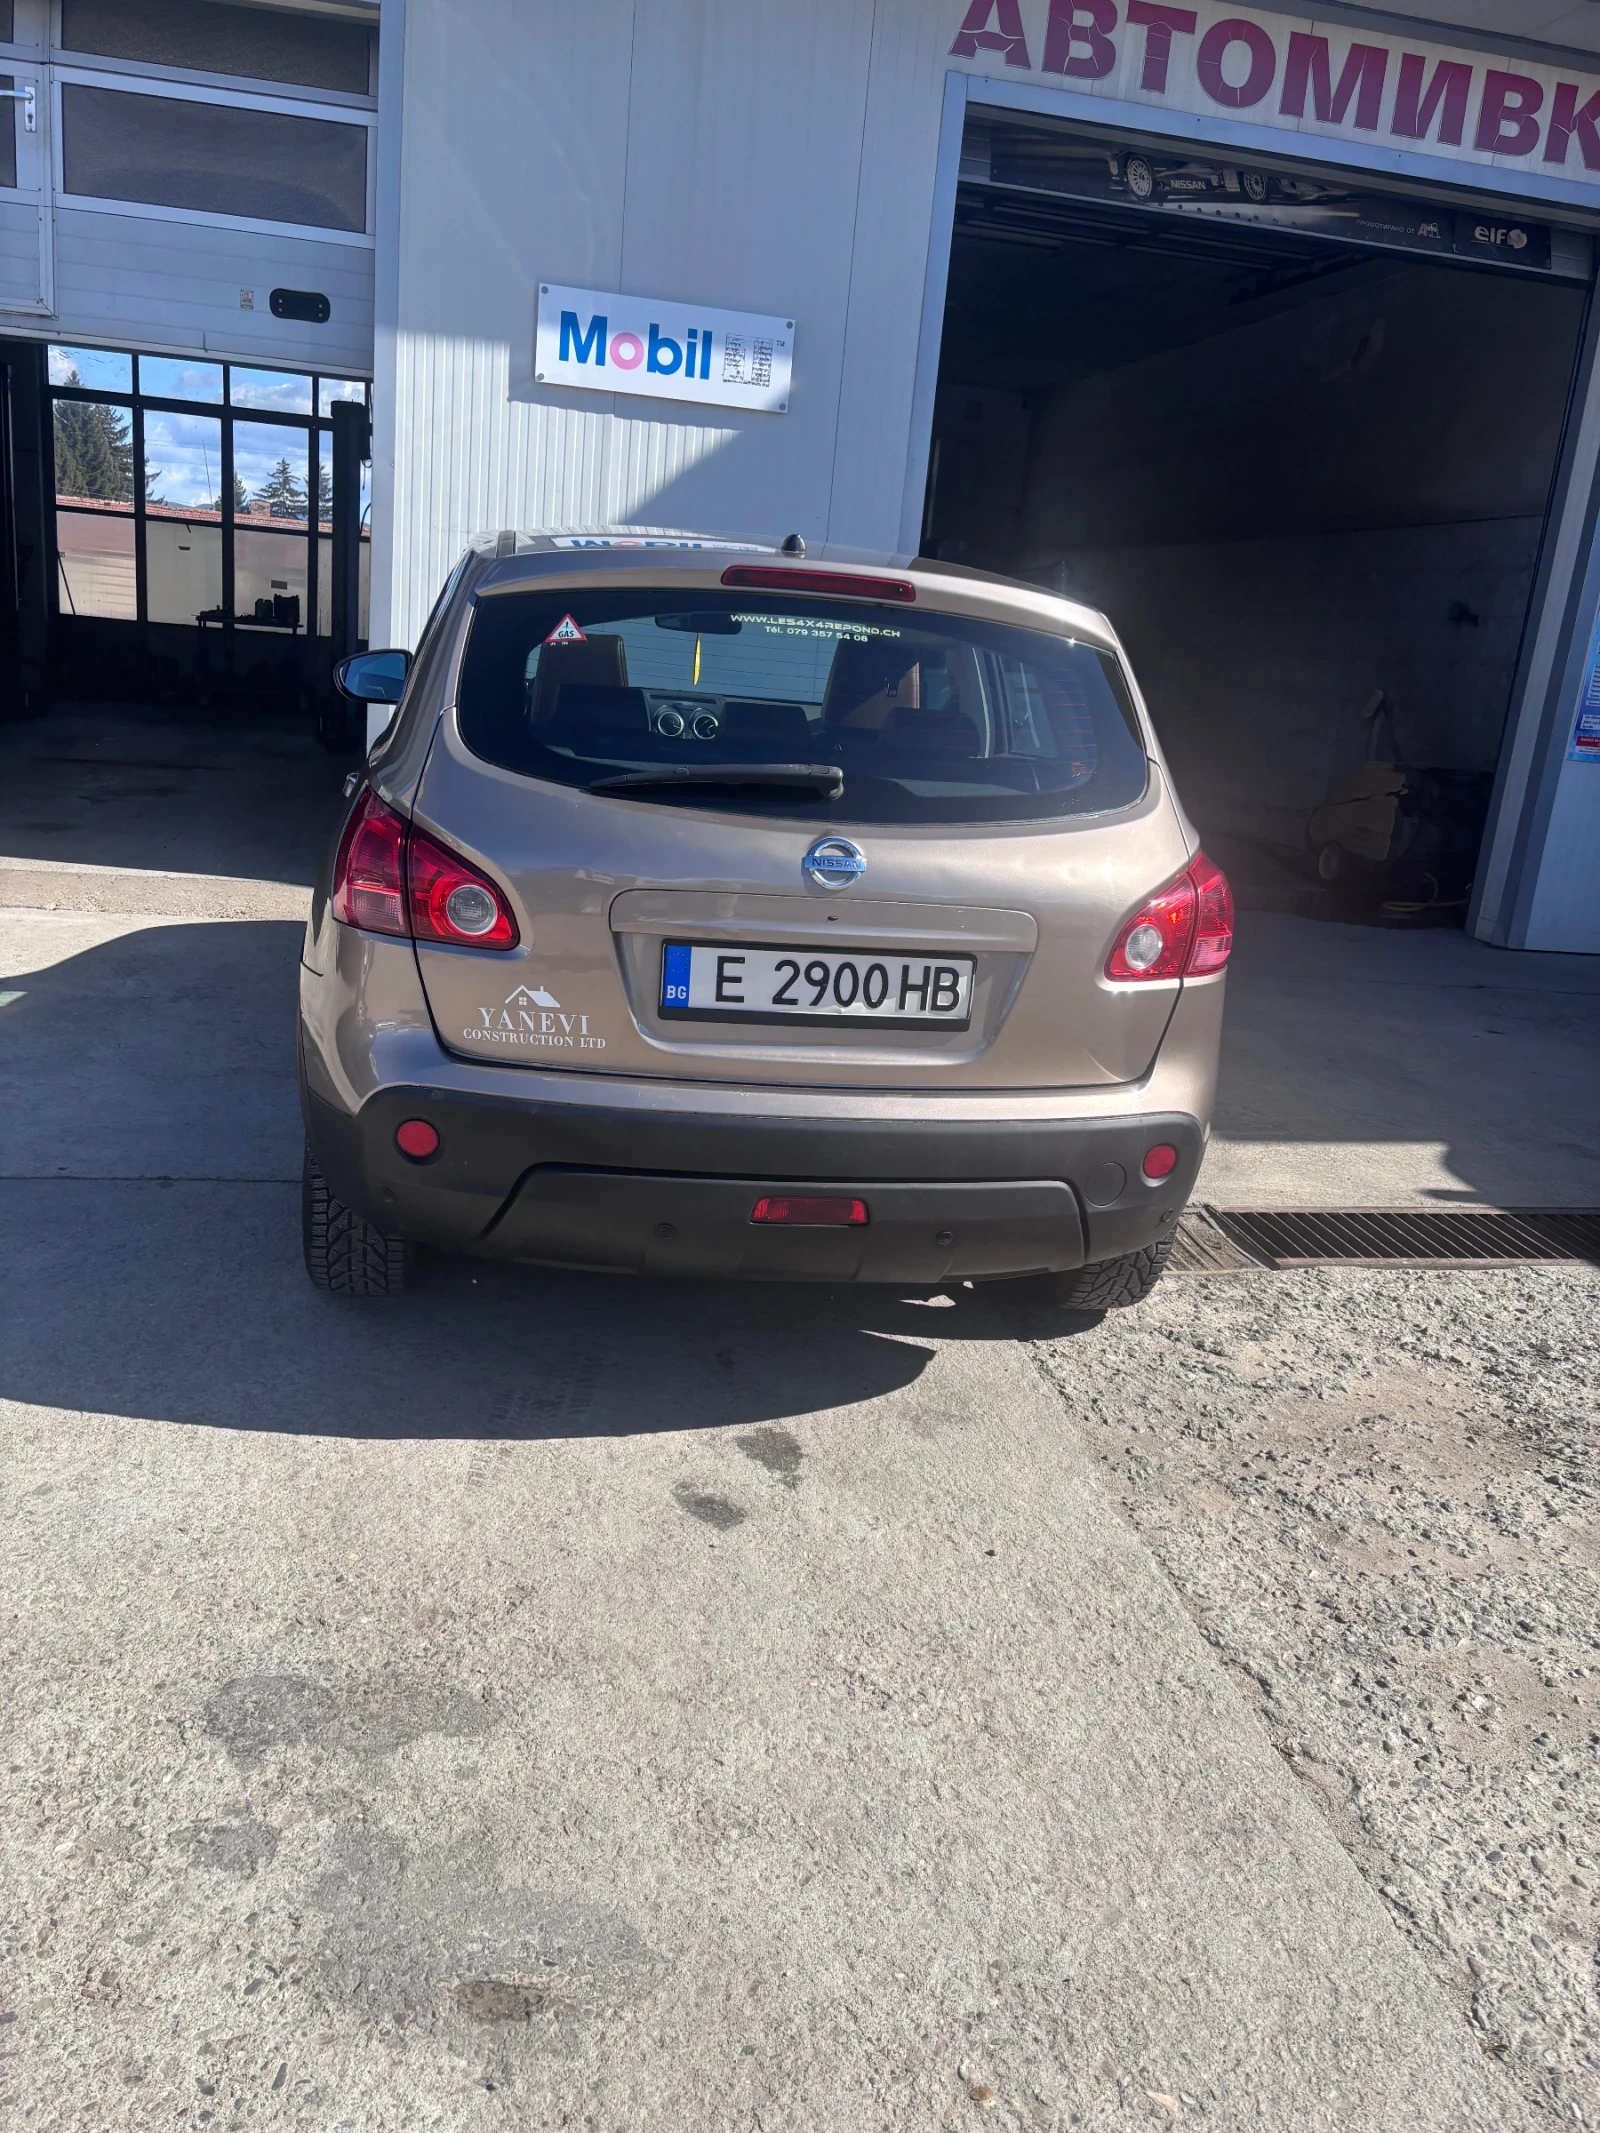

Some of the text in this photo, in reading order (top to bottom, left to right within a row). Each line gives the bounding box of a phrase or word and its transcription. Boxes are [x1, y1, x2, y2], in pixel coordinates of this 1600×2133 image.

[1170, 179, 1207, 190] NISSAN
[1356, 219, 1405, 233] ПРОМОТИРАНО
[1474, 225, 1507, 245] elf
[558, 310, 713, 380] Mobil
[558, 630, 574, 638] GAS
[730, 614, 901, 638] WWW.LES4X4REPOND.CH
[764, 625, 868, 642] Tél. 079 357 54 08
[812, 858, 861, 869] NISSAN
[715, 956, 745, 1004] E
[666, 984, 687, 1000] BG
[478, 1007, 589, 1035] YANEVI
[463, 1028, 606, 1049] CONSTRUCTION LTD
